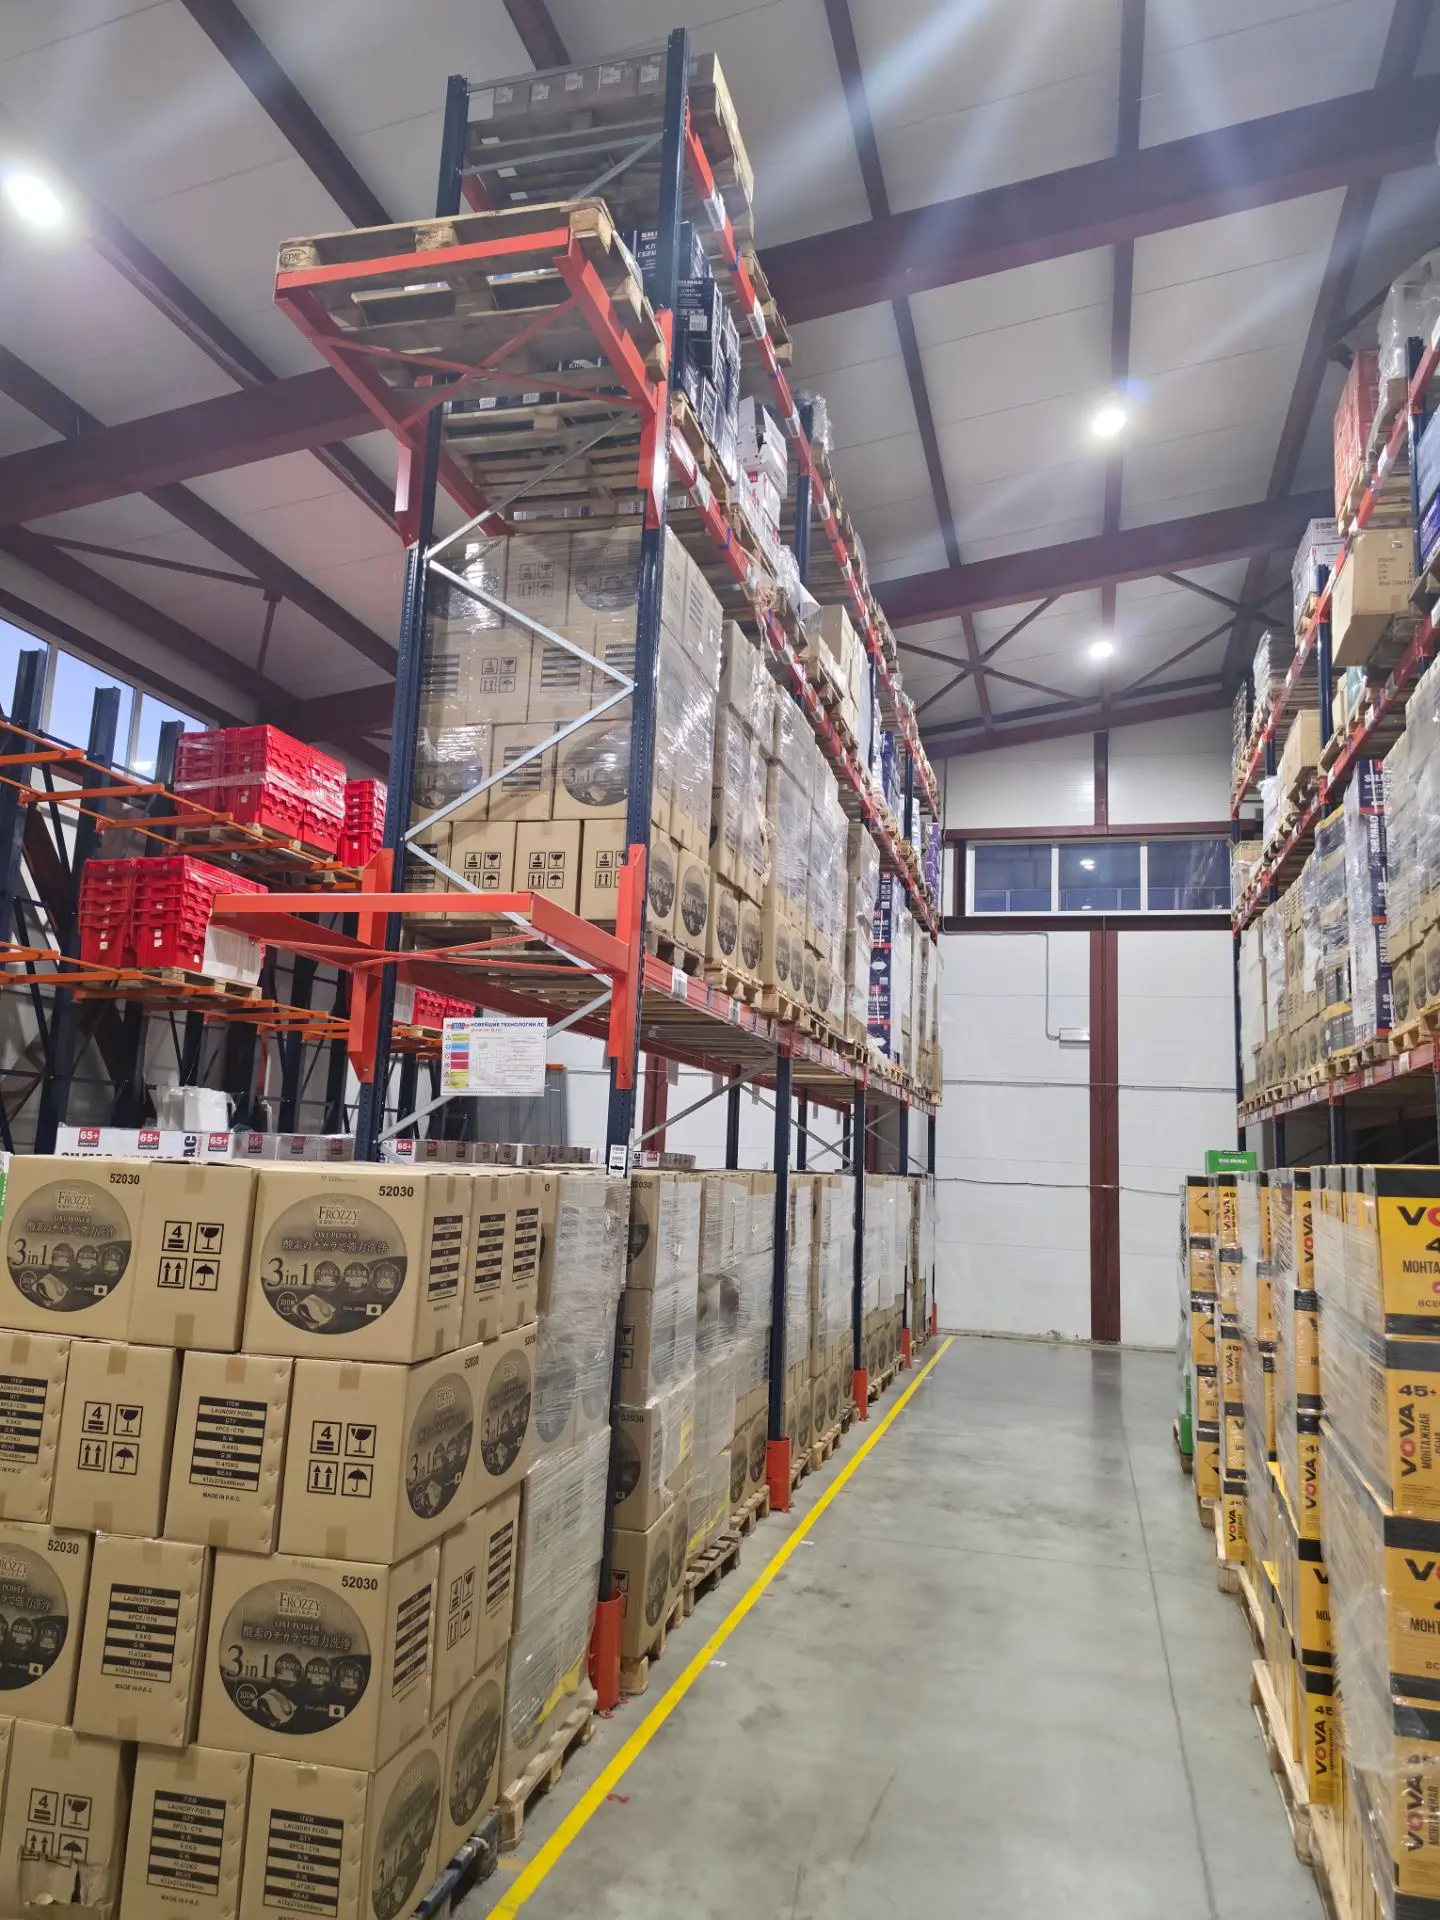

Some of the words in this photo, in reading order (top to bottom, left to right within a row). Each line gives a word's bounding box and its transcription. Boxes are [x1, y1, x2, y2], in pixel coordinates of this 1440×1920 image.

[79, 1130, 99, 1140] 65+
[139, 1133, 159, 1143] 65+
[209, 1135, 228, 1145] 65+
[397, 1142, 412, 1150] 65+
[110, 1173, 140, 1184] 52030
[378, 1185, 414, 1197] 52030
[318, 1205, 360, 1221] FROZZY
[172, 1226, 182, 1238] 4
[1302, 1213, 1314, 1263] VOVA
[1398, 1384, 1438, 1398] 45+
[92, 1406, 102, 1419] 4
[211, 1408, 237, 1416] LAUNDRY
[320, 1426, 332, 1439] 4
[1398, 1402, 1418, 1477] VOVA
[1418, 1413, 1433, 1470] МОНТАЖНАЯ
[1304, 1458, 1317, 1510] VOVA
[202, 1491, 218, 1499] MADE
[1228, 1508, 1237, 1542] VOVA
[47, 1540, 80, 1555] 52030
[341, 1576, 378, 1590] 52030
[124, 1596, 148, 1604] LAUNDRY
[149, 1598, 166, 1606] PODS
[279, 1592, 322, 1611] FROZZY
[115, 1682, 131, 1690] MADE
[1314, 1720, 1328, 1775] VOVA
[38, 1794, 49, 1808] 4
[168, 1803, 192, 1813] LAUNDRY
[194, 1807, 212, 1816] PODS
[1406, 1774, 1425, 1852] VOVA
[300, 1815, 314, 1823] ITEM
[284, 1823, 311, 1833] LAUNDRY
[312, 1828, 328, 1836] PODS
[300, 1834, 312, 1842] QTY
